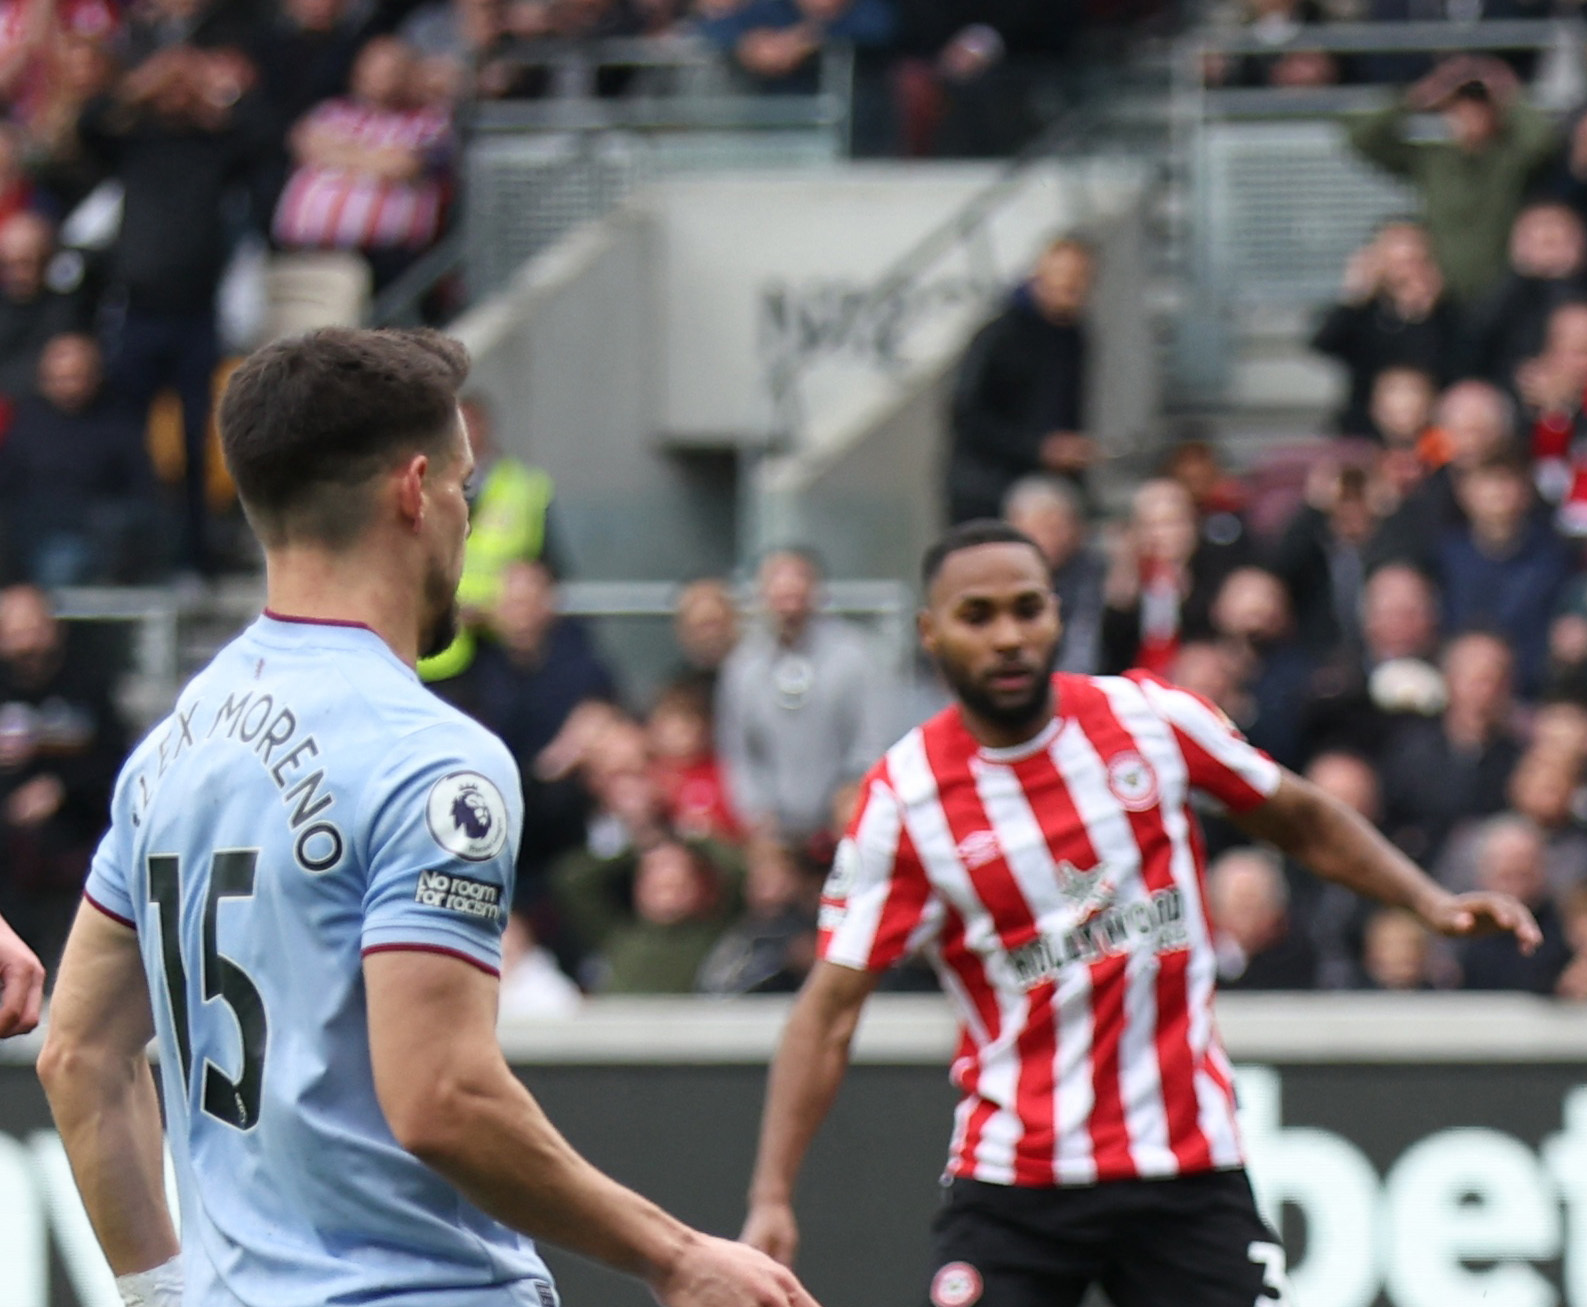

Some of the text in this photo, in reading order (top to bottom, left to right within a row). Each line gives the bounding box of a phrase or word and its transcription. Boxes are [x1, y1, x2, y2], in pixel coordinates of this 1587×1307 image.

[206, 690, 344, 873] MORENO
[414, 884, 500, 920] for racism
[419, 870, 497, 902] No room
[146, 849, 269, 1134] 15
